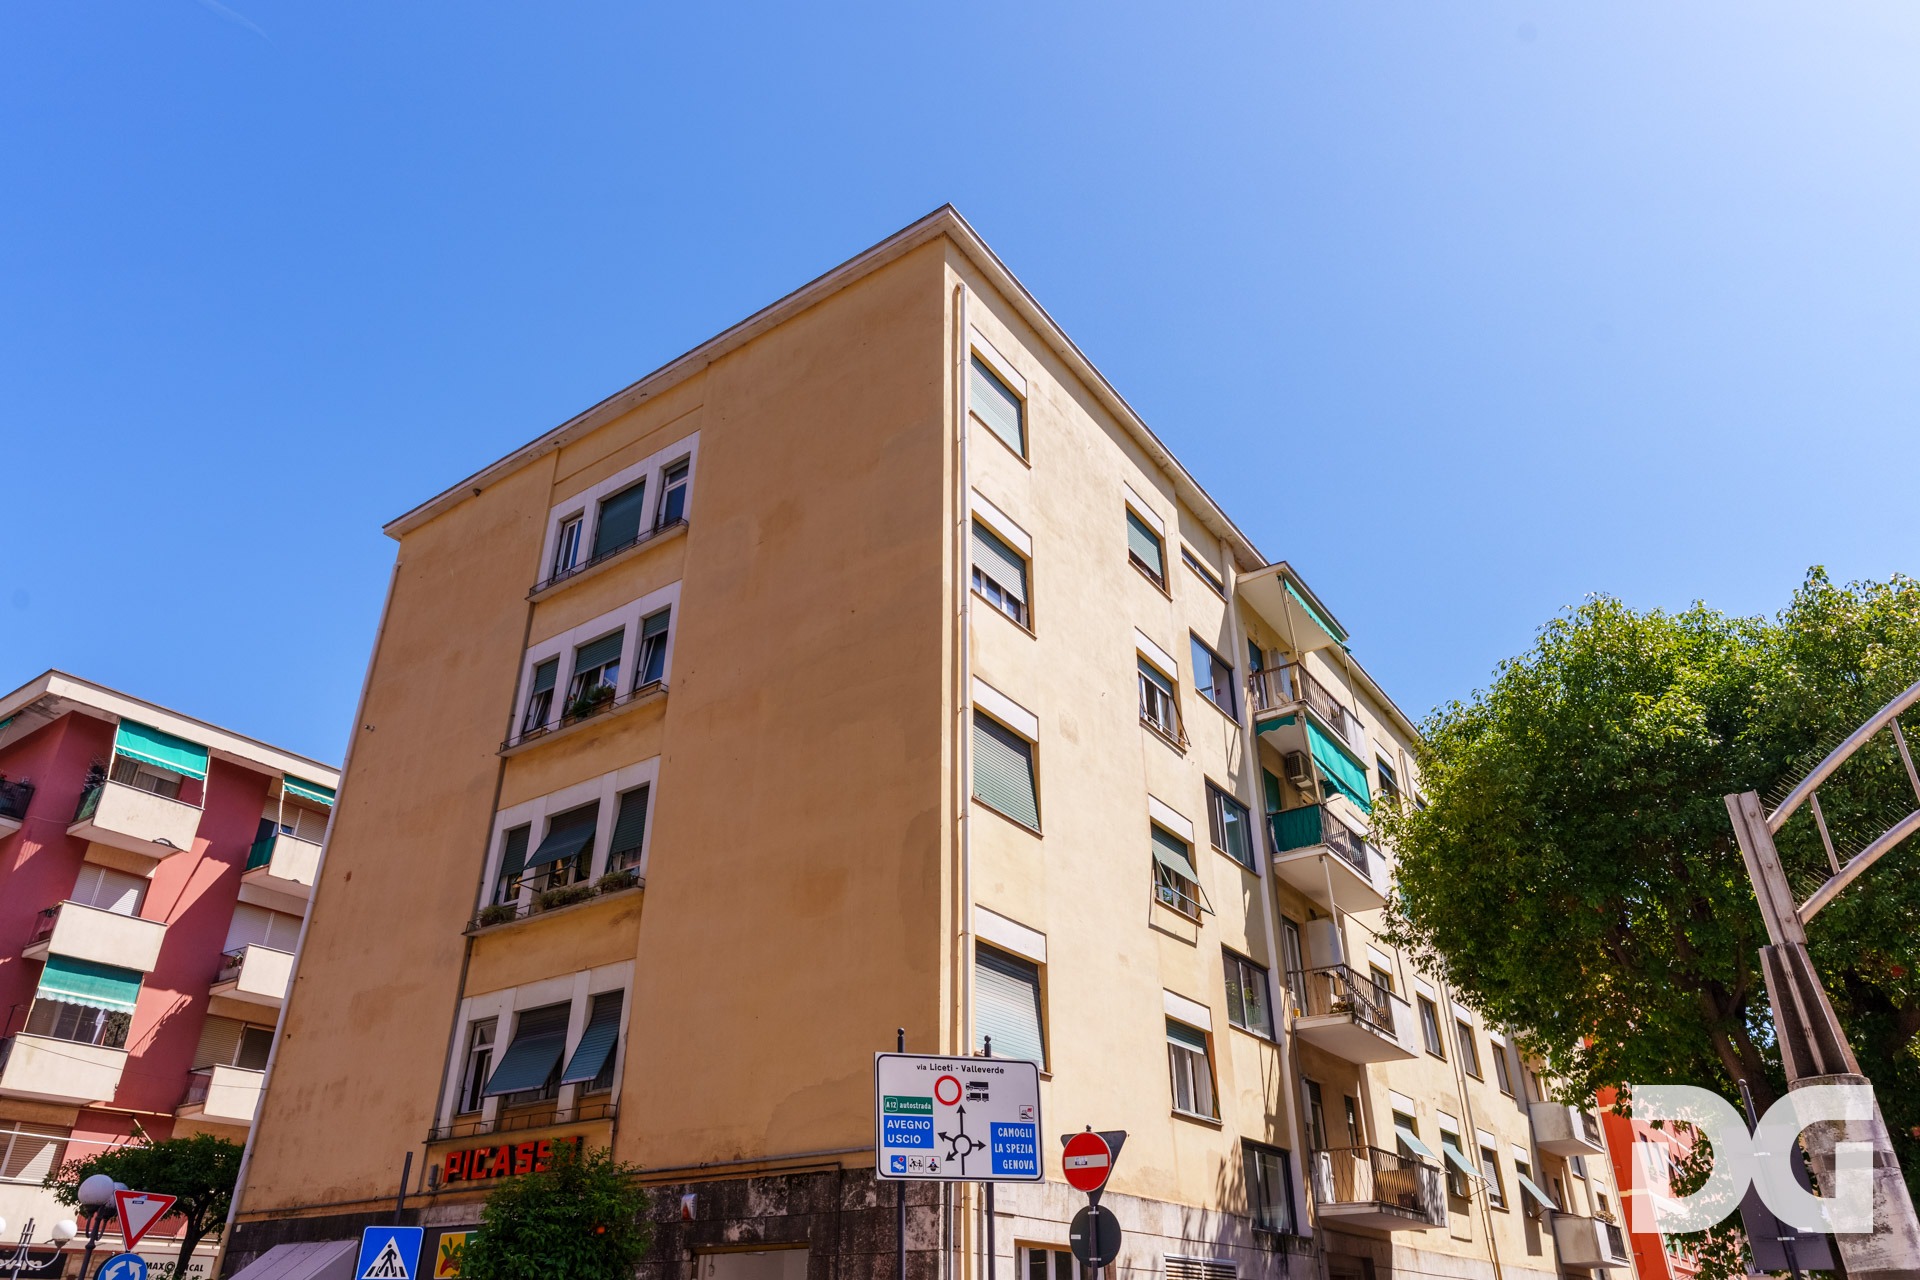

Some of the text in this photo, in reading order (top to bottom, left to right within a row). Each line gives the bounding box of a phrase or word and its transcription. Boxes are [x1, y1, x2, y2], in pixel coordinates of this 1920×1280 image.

[916, 1063, 927, 1071] via
[929, 1063, 953, 1072] Liceti
[961, 1064, 1005, 1074] Valleverde
[886, 1101, 897, 1109] A12
[899, 1102, 932, 1110] autostrada
[886, 1119, 931, 1130] AVEGNO
[997, 1127, 1033, 1138] CAMOGLI
[887, 1134, 921, 1144] USCIO
[994, 1143, 1034, 1154] LA SPEZIA
[1003, 1159, 1035, 1170] GENOVA
